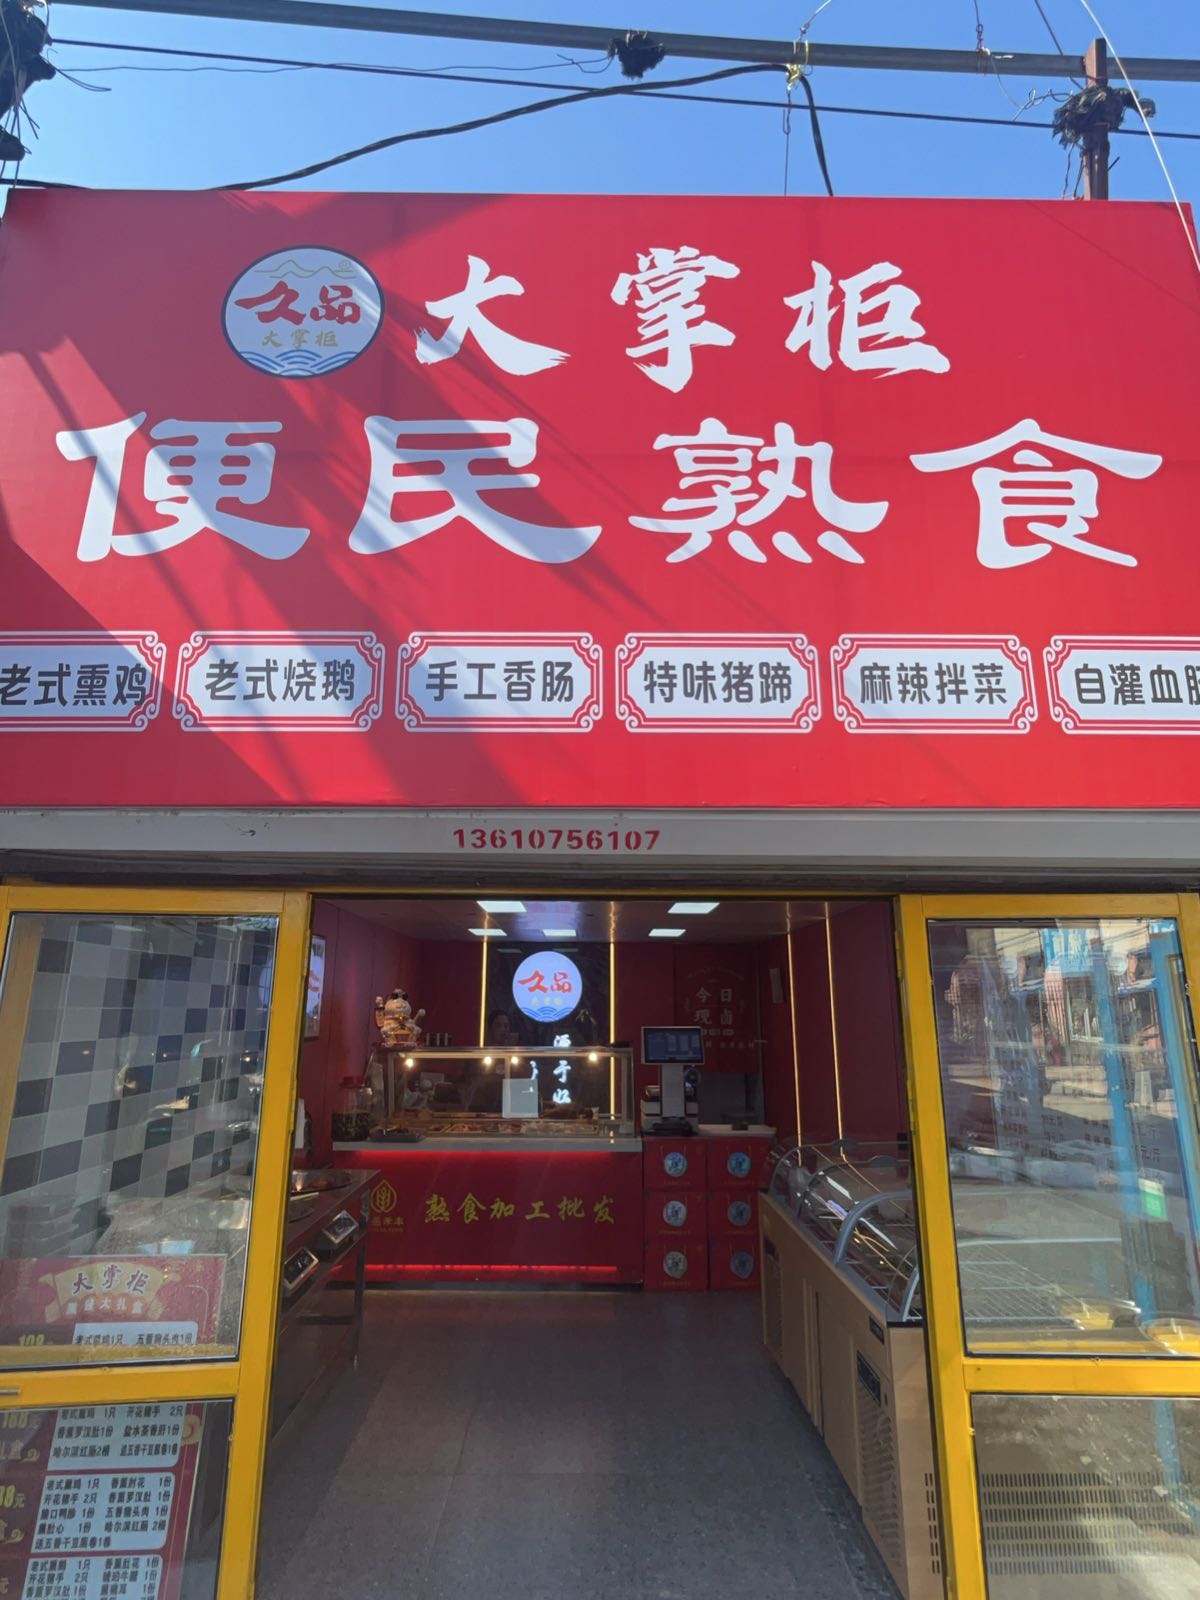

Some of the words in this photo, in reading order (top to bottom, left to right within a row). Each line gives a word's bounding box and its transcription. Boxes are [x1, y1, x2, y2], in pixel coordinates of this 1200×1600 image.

[234, 281, 361, 325] 久品
[414, 244, 951, 393] 大掌柜
[262, 328, 338, 349] 大掌柜
[56, 411, 1163, 569] 便民熟食
[0, 662, 147, 706] 老式熏鸡
[205, 659, 356, 702] 老式烧鹅
[426, 659, 575, 703] 手工香肠
[643, 660, 793, 704] 特味猪蹄
[859, 662, 1007, 705] 麻辣拌菜
[453, 829, 661, 850] 13610756107
[518, 969, 573, 994] 久品
[695, 986, 733, 1003] 今日
[424, 1192, 615, 1225] 熟食加工批发
[72, 1264, 149, 1295] 大掌柜
